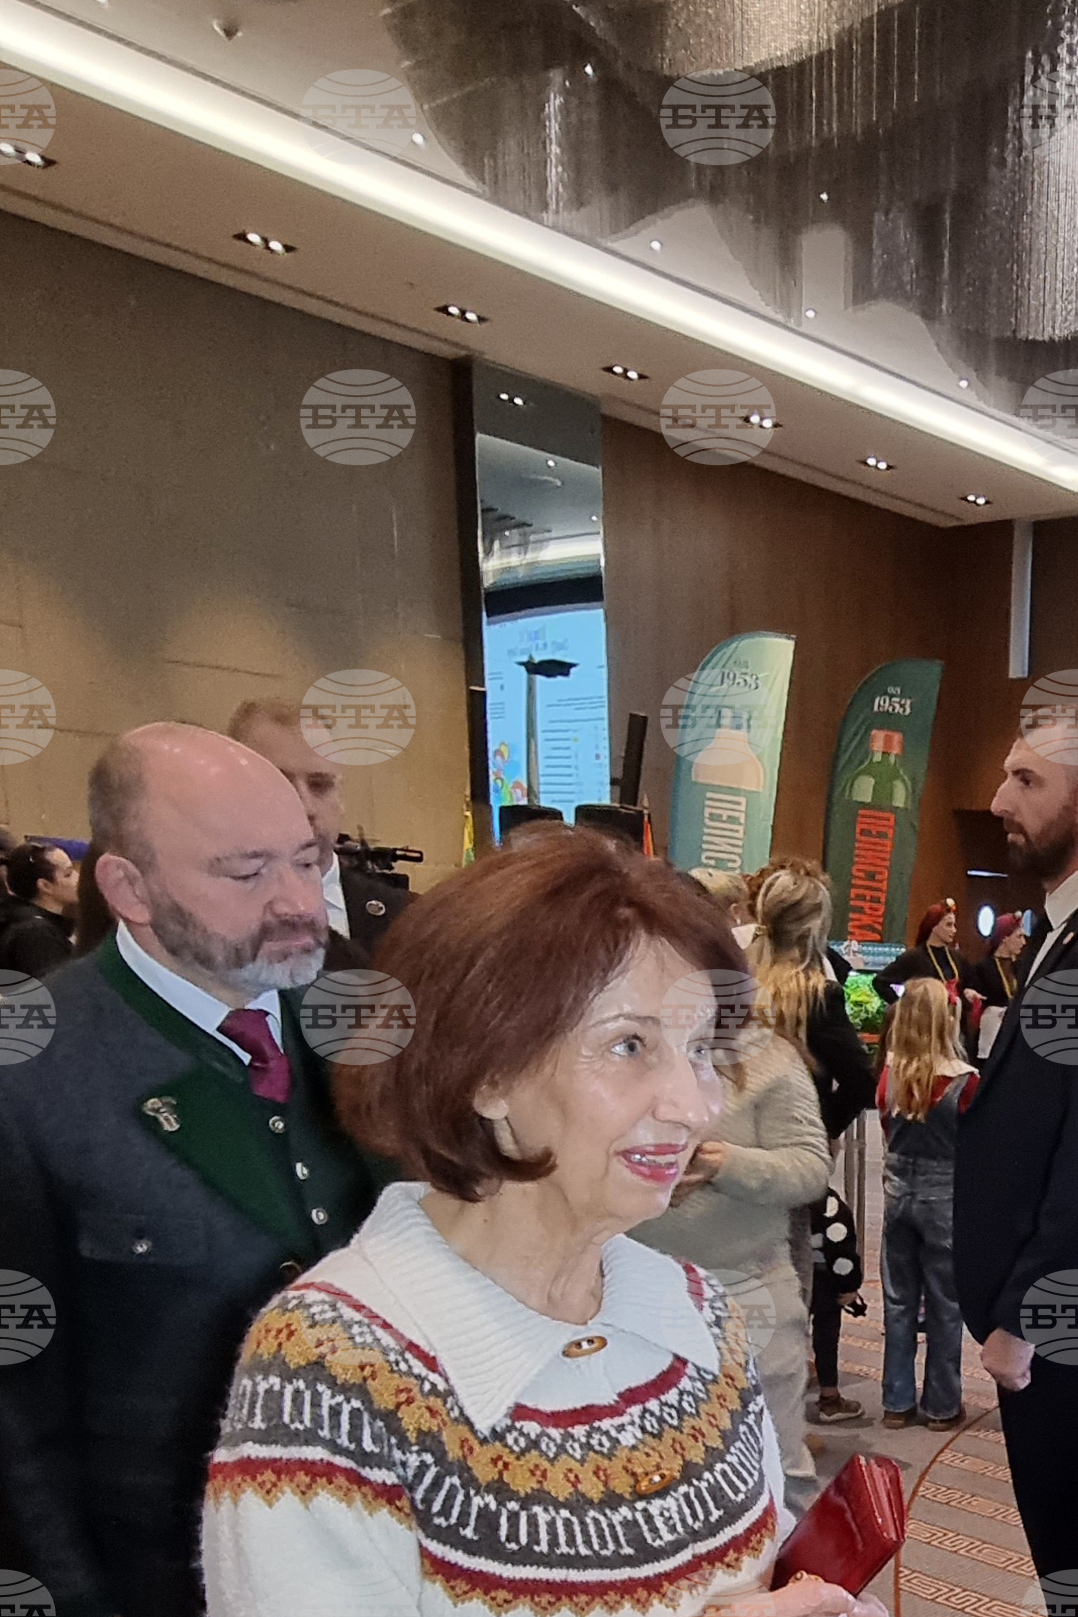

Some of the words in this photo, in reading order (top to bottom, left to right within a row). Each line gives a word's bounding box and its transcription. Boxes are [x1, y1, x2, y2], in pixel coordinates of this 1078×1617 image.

[720, 670, 760, 691] 1953
[872, 696, 913, 717] 1953
[701, 791, 747, 874] ПЕЛИС
[847, 809, 896, 943] ПЕЛИСТЕРКА
